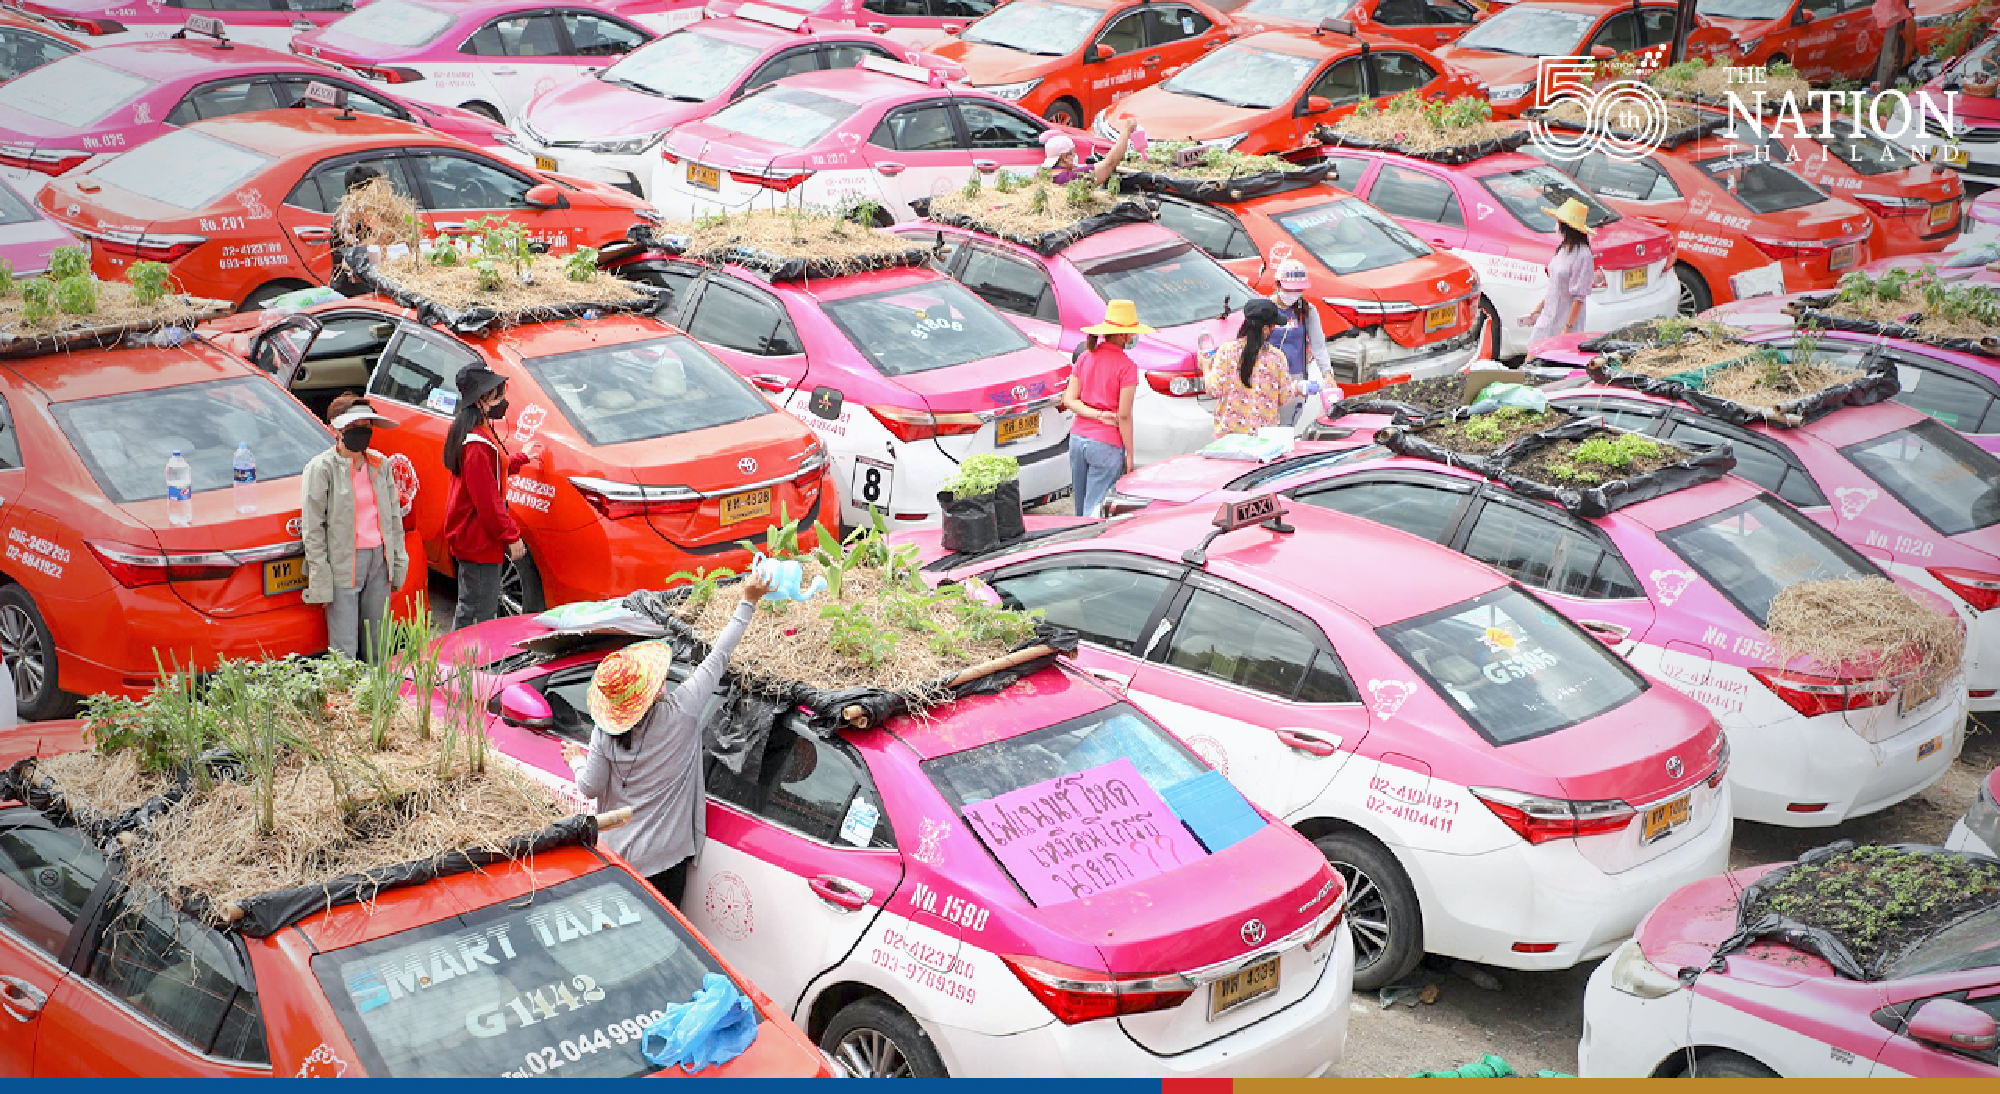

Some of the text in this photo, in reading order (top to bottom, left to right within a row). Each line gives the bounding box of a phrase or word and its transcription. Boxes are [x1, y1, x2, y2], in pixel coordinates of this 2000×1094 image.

[863, 468, 881, 502] 8
[1238, 498, 1274, 521] TAXI
[346, 891, 643, 1014] SMART TAXI
